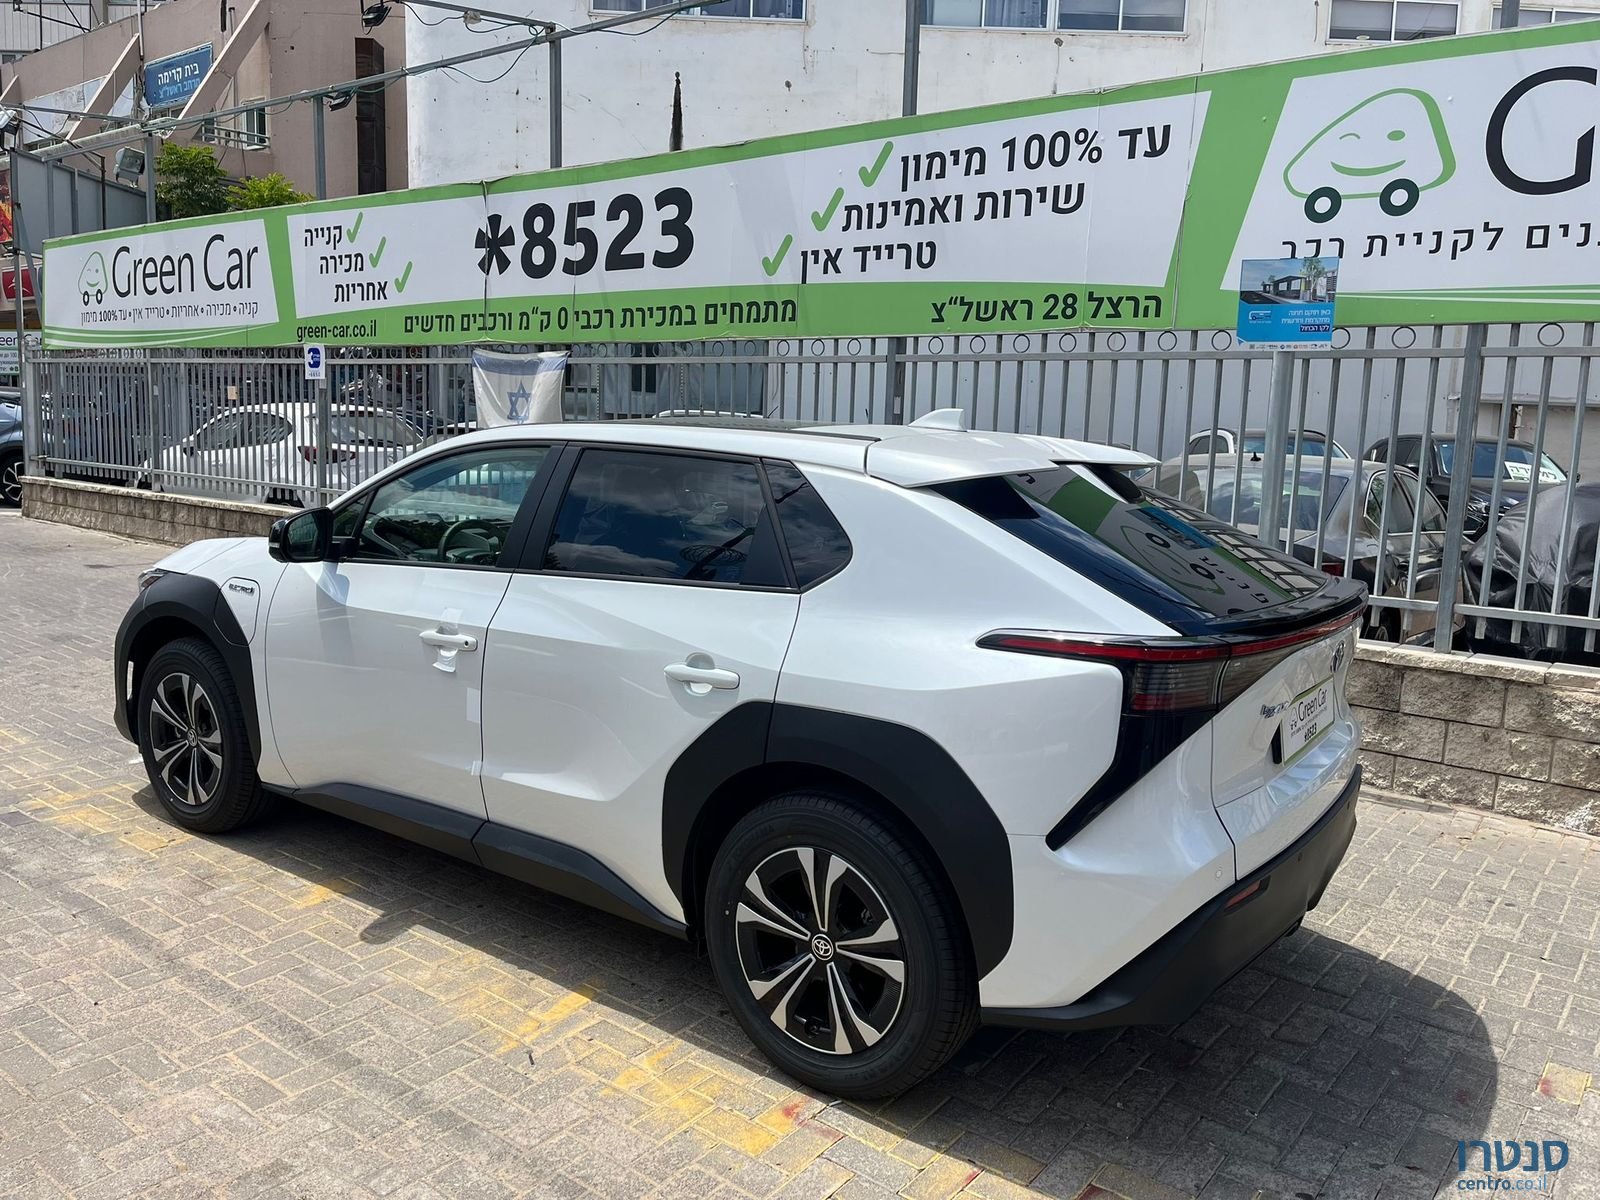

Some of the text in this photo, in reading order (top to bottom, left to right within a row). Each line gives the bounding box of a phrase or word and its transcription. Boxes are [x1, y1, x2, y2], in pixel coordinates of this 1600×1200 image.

[184, 63, 200, 78] בית
[900, 124, 1172, 192] עד 100% מימון
[842, 182, 1086, 232] שירות ואמינות
[304, 225, 342, 250] קנייה
[1363, 221, 1504, 260] לקניית
[1526, 222, 1600, 249] נים
[112, 234, 258, 298] Green Car
[320, 252, 364, 275] מכירה
[800, 240, 937, 285] טרייד אין
[334, 280, 388, 303] אחריות
[930, 290, 1162, 324] הרצל 28 ראשל"צ
[80, 301, 258, 326] קניה מכירה אחריות טרייד אין עד 100% מימון
[296, 320, 377, 341] green-car.co.il
[404, 299, 797, 334] מתמחים במכירת רכבי 0 ק"מ ורכבים חדשים
[1298, 697, 1317, 722] Green
[1318, 688, 1327, 708] Car
